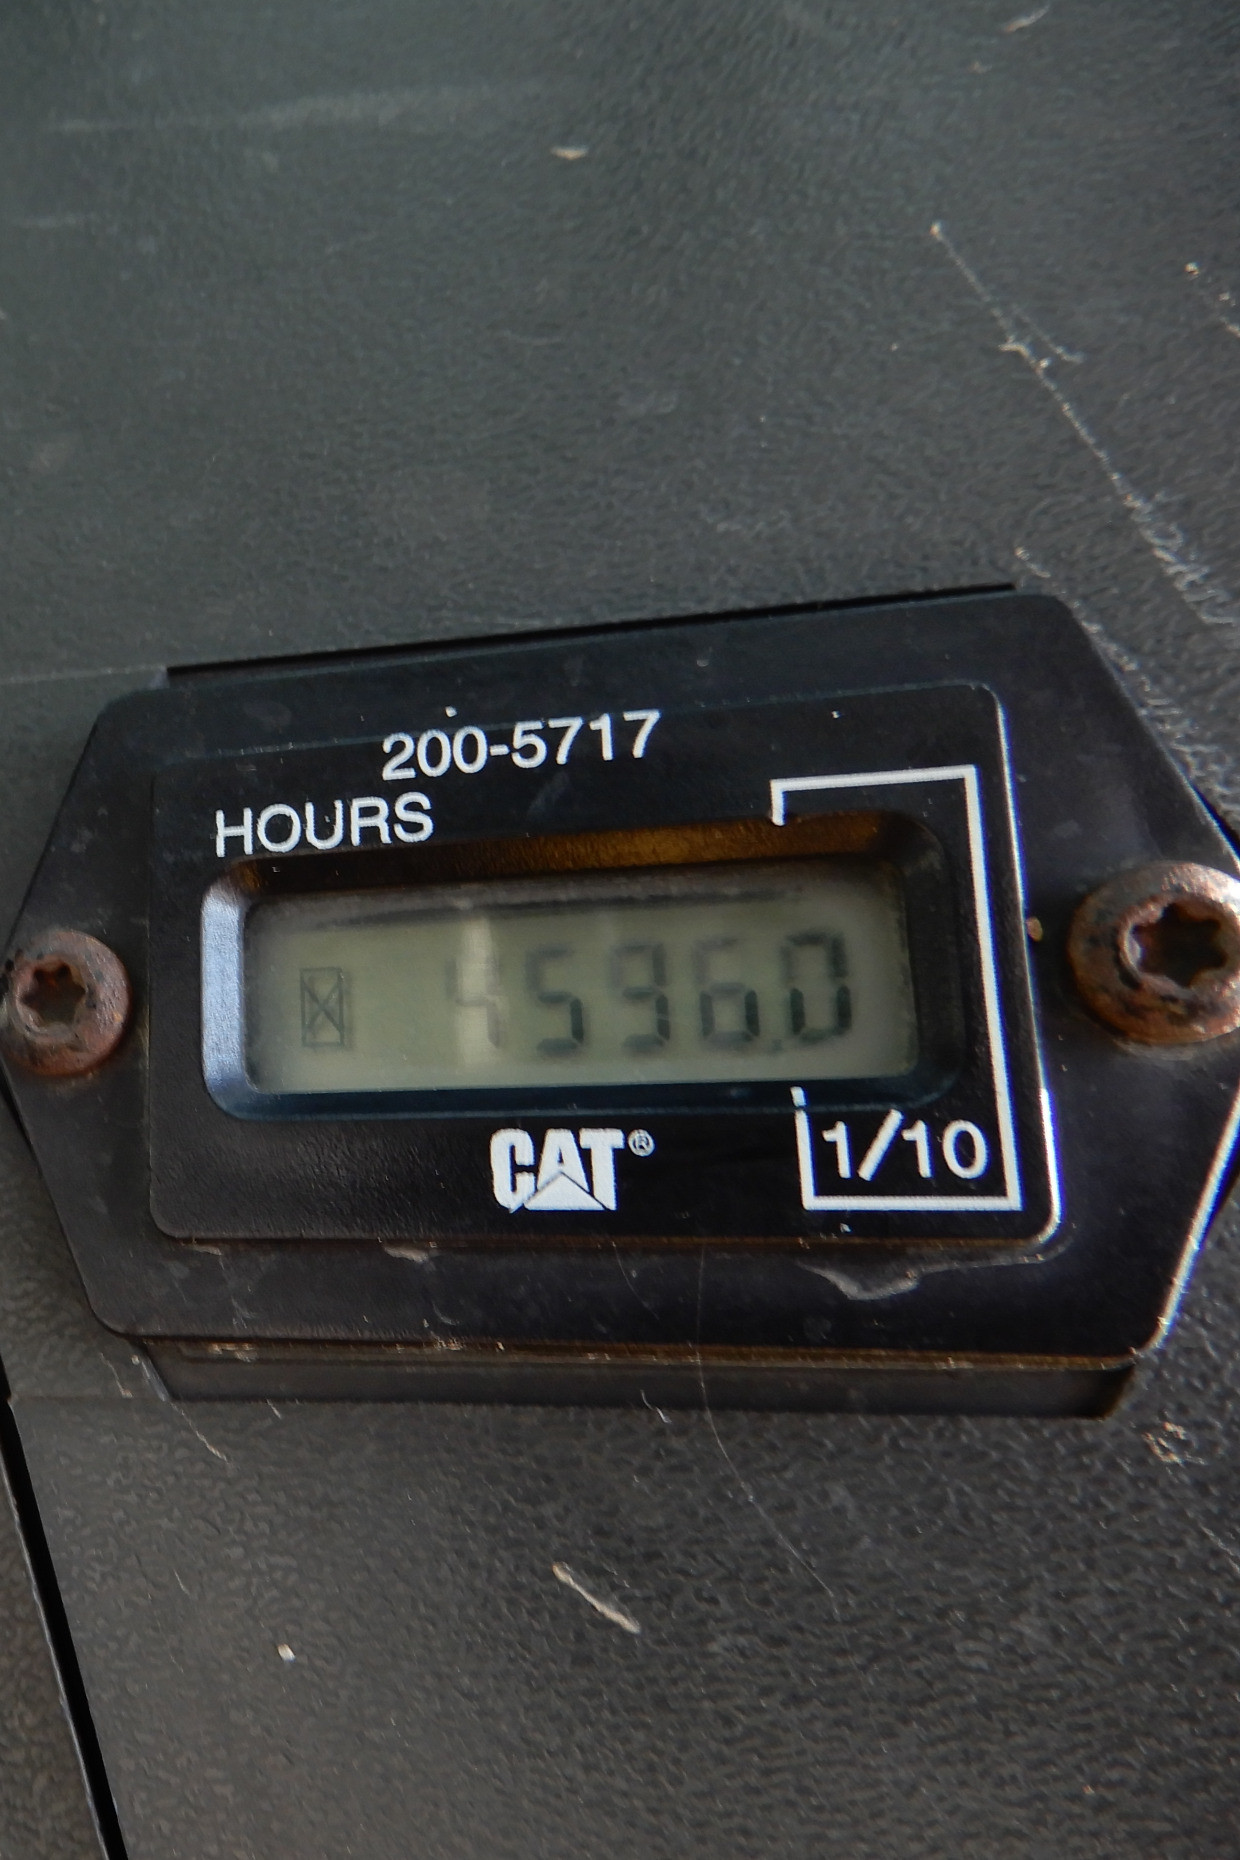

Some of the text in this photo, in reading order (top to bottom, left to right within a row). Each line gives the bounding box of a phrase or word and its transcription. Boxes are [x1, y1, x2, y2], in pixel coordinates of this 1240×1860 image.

[382, 709, 661, 781] 200-5717
[215, 792, 435, 858] HOURS
[822, 1110, 989, 1182] 1/10
